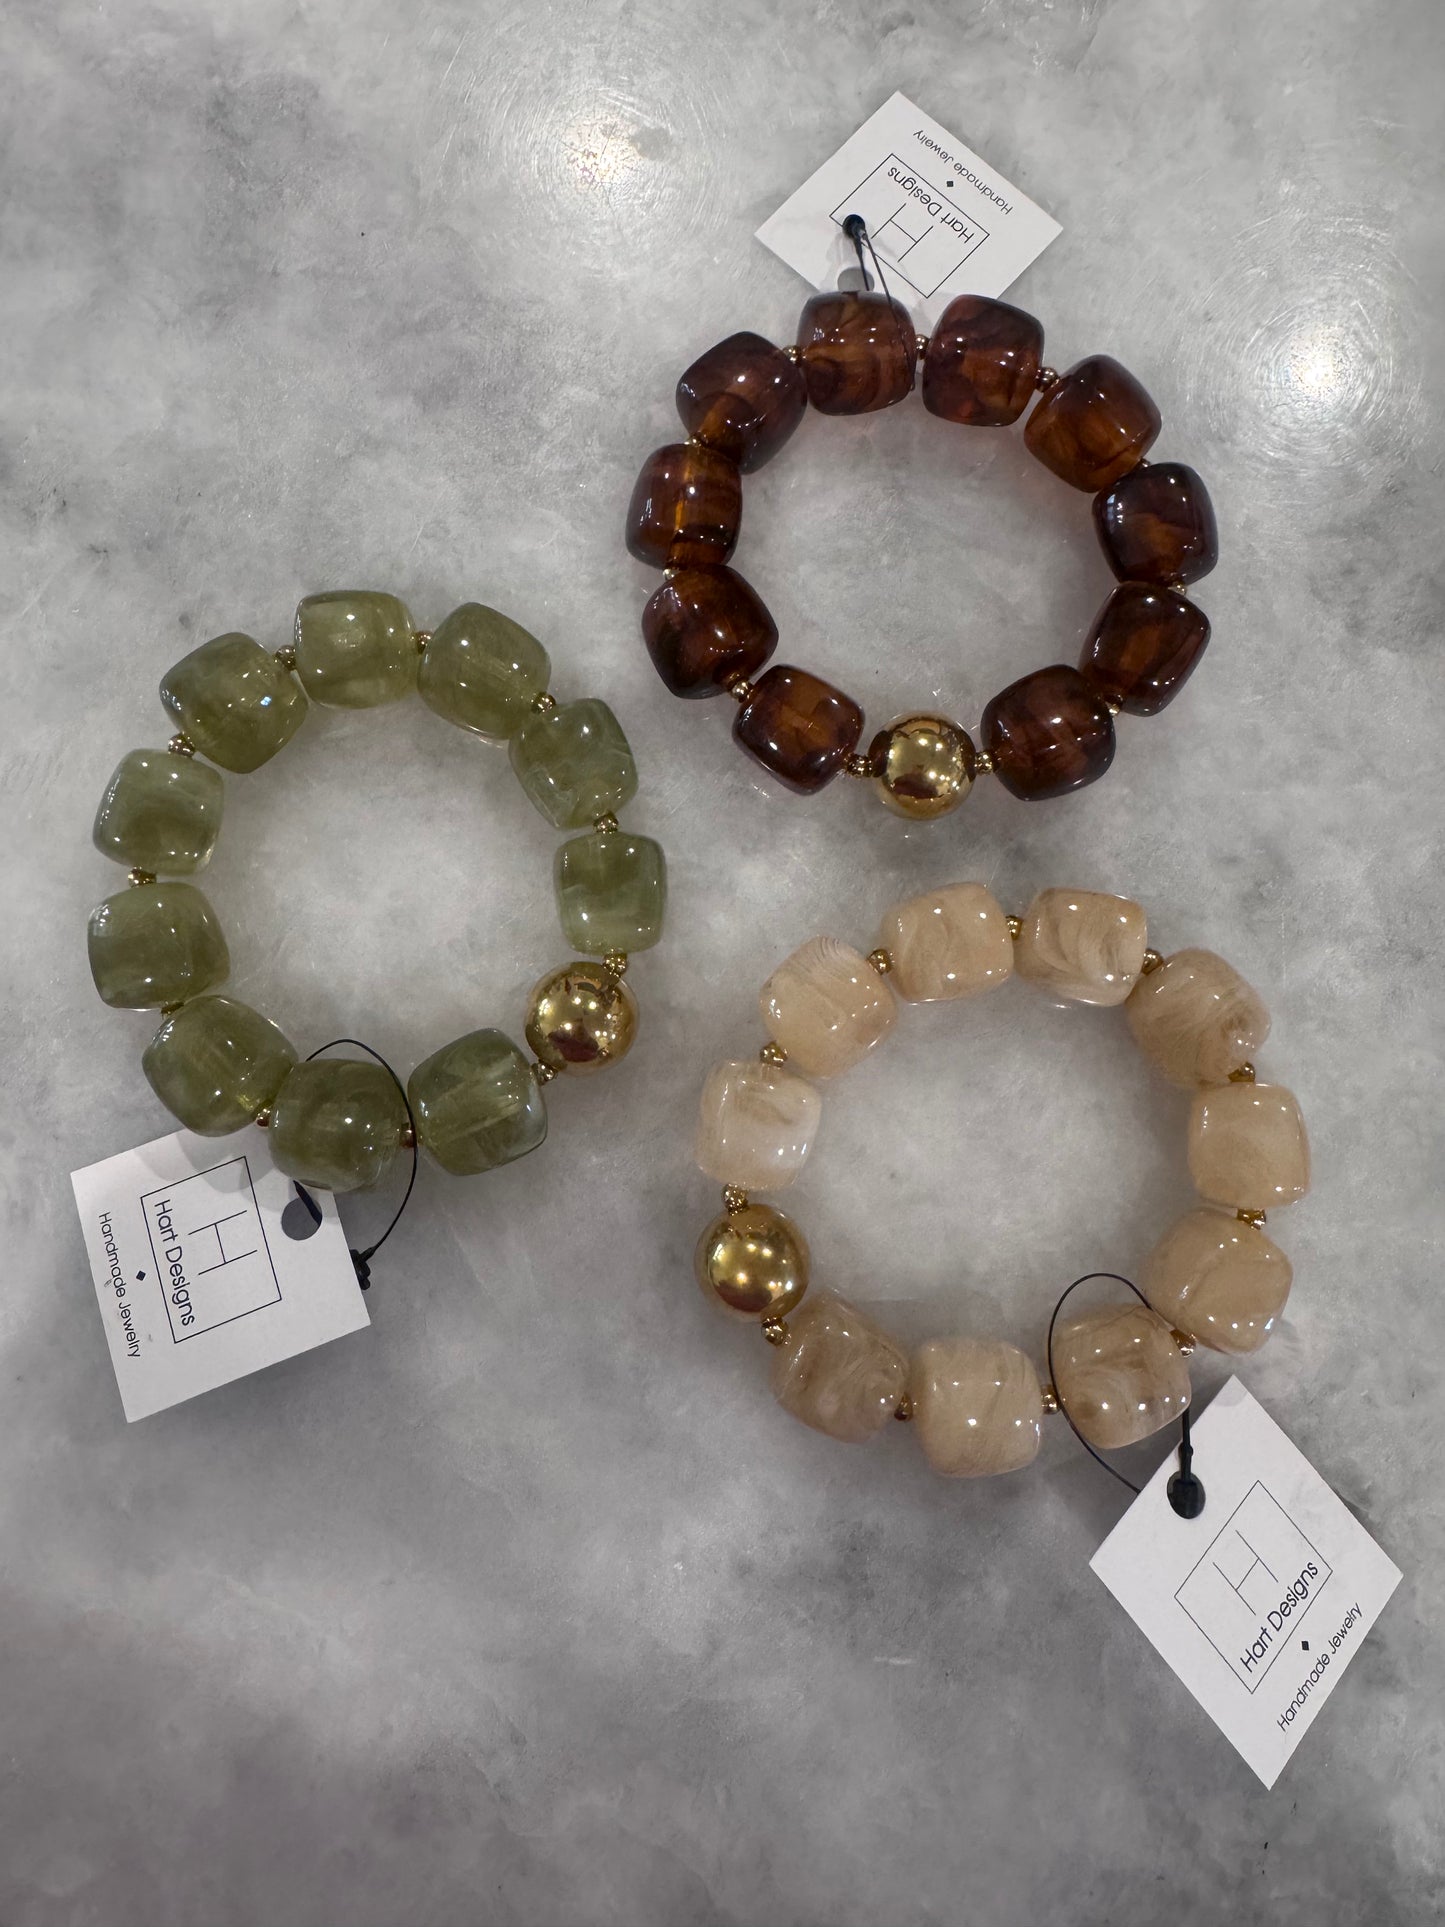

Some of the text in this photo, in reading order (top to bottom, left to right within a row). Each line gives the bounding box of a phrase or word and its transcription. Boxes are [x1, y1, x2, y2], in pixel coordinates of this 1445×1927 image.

[887, 166, 975, 244] Hart Designs
[913, 129, 1014, 215] Handmade Jewelry
[99, 1211, 141, 1358] Handmade Jewelry
[154, 1199, 195, 1326] Hart Designs
[1240, 1561, 1319, 1673] Hart Designs
[1276, 1602, 1363, 1732] Handmade Jewelry
